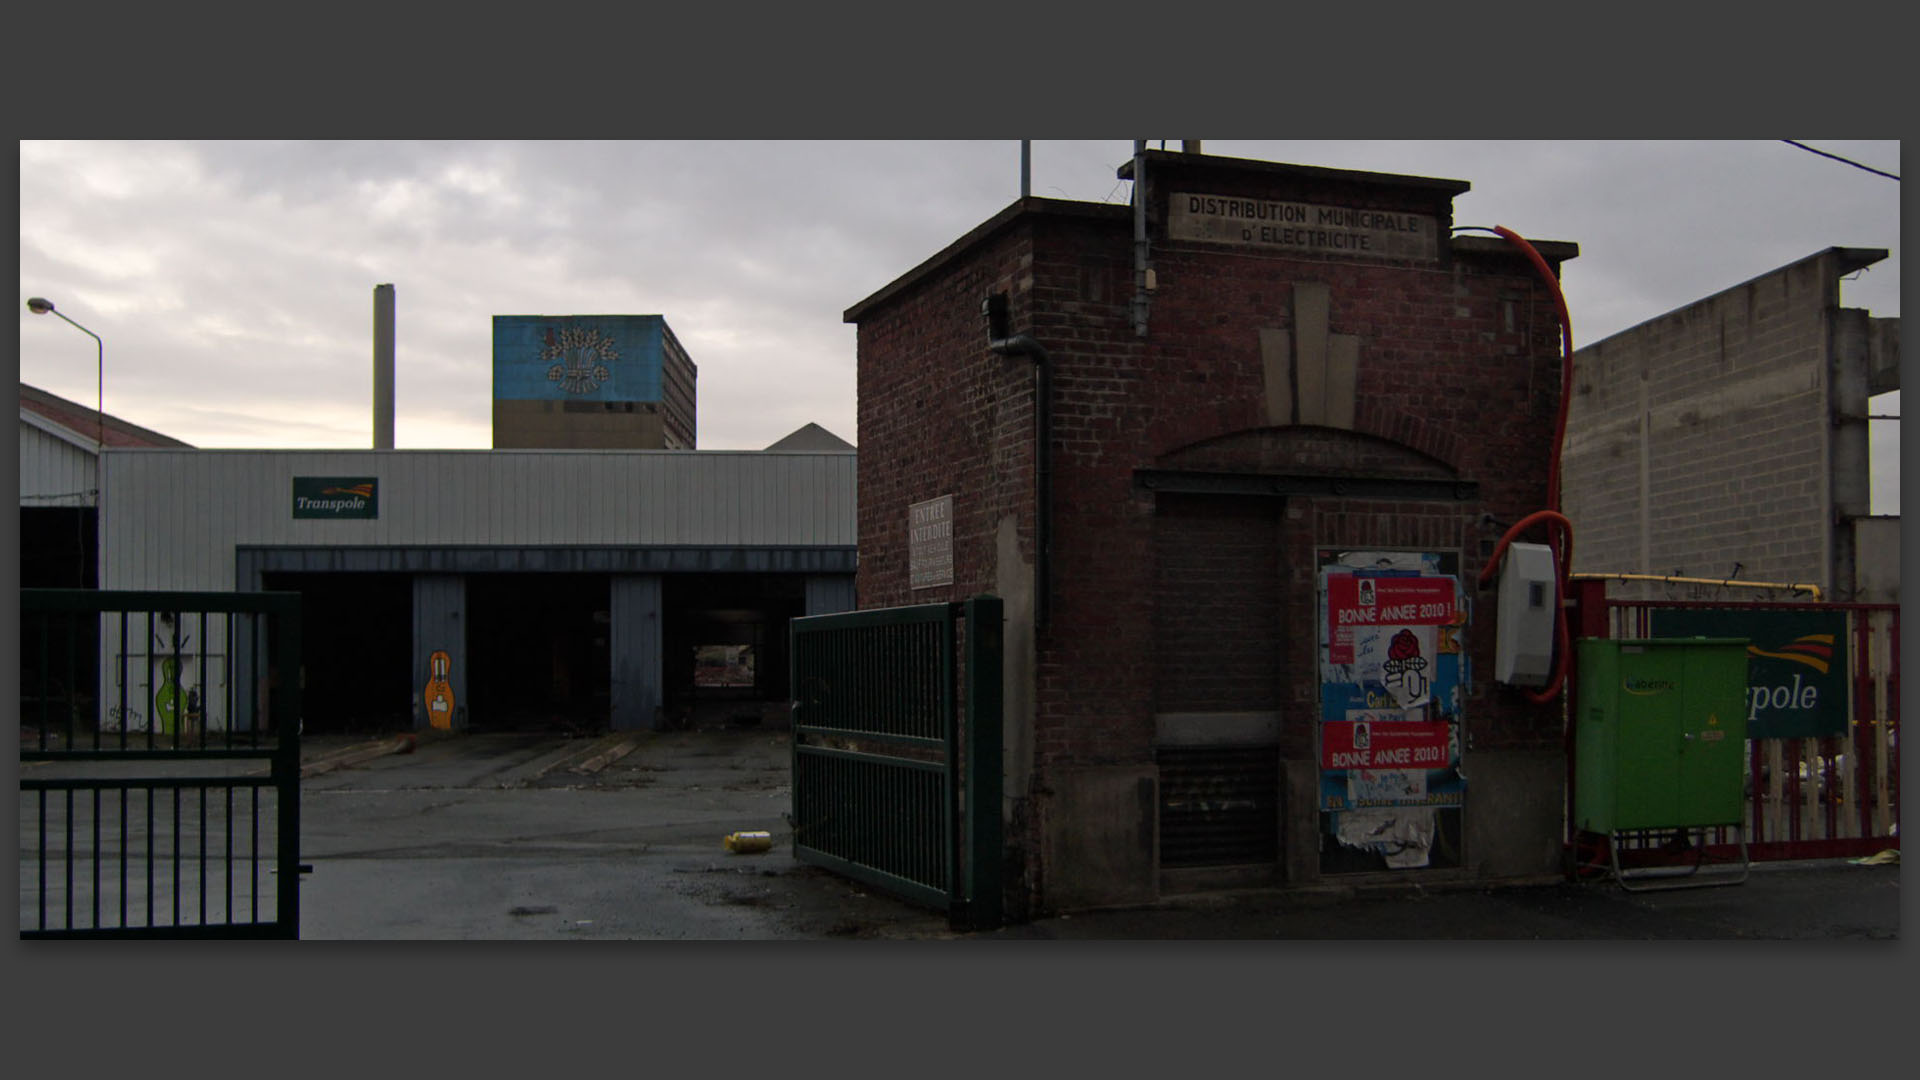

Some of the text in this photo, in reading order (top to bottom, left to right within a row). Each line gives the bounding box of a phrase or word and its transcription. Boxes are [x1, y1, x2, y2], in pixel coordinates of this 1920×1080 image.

[1189, 197, 1419, 233] DISTRIBUTION MUNICIPALE
[297, 496, 366, 513] Transpole
[915, 502, 945, 524] ENTREE
[910, 520, 951, 545] INTERDITE
[1338, 606, 1376, 624] BONNE
[1379, 604, 1417, 621] ANNEE
[1419, 602, 1444, 618] 2010
[1332, 750, 1370, 768] BONNE
[1374, 747, 1411, 764] ANNEE
[1413, 746, 1439, 761] 2010
